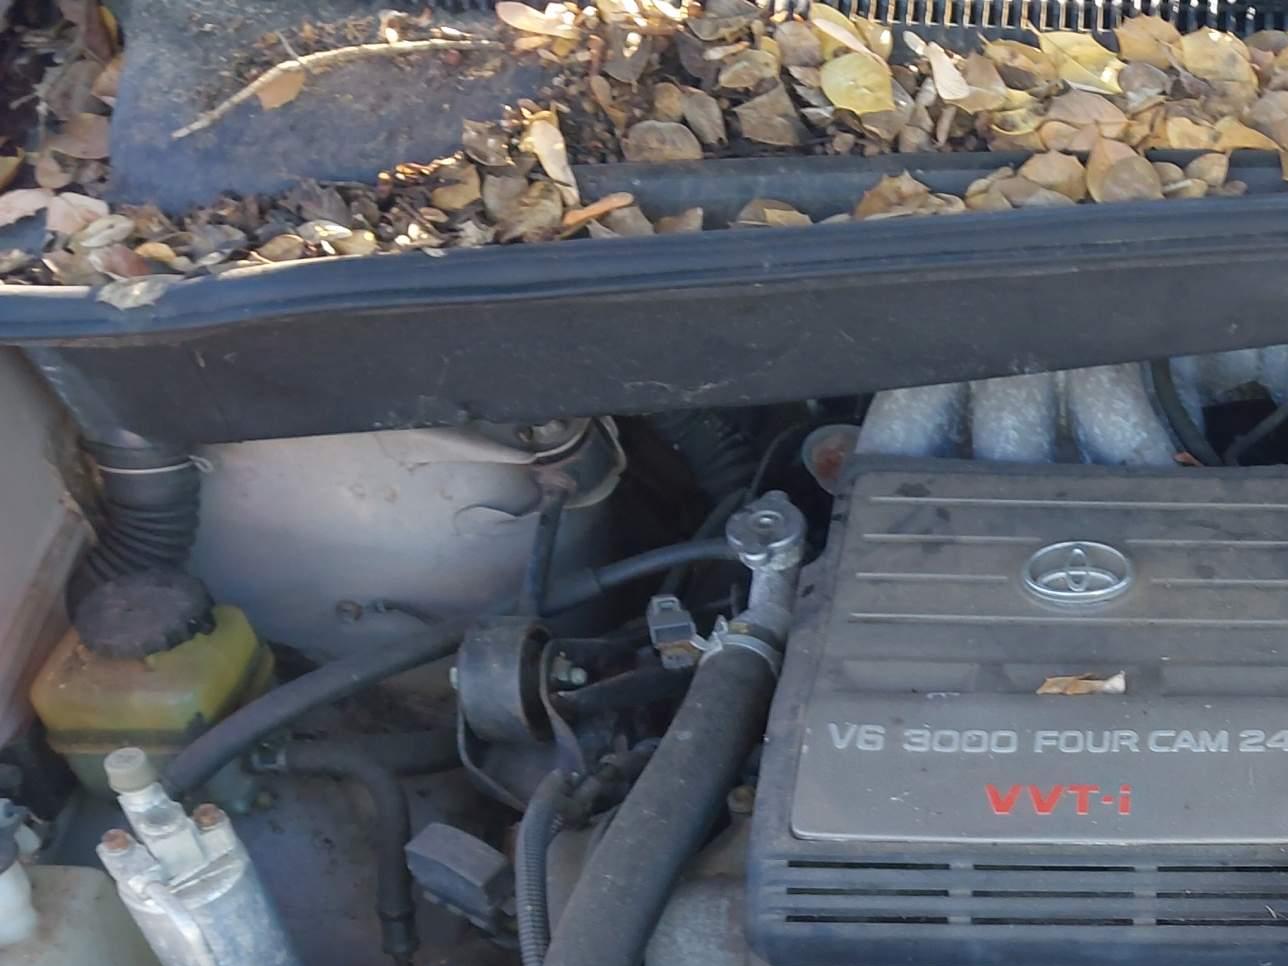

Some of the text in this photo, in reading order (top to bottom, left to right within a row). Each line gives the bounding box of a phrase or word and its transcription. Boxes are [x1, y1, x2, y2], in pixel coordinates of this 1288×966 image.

[828, 723, 886, 751] V6
[903, 728, 1018, 753] 3000
[1033, 730, 1140, 753] FOUR
[1148, 730, 1230, 753] CAM
[985, 784, 1132, 815] VVT-i
